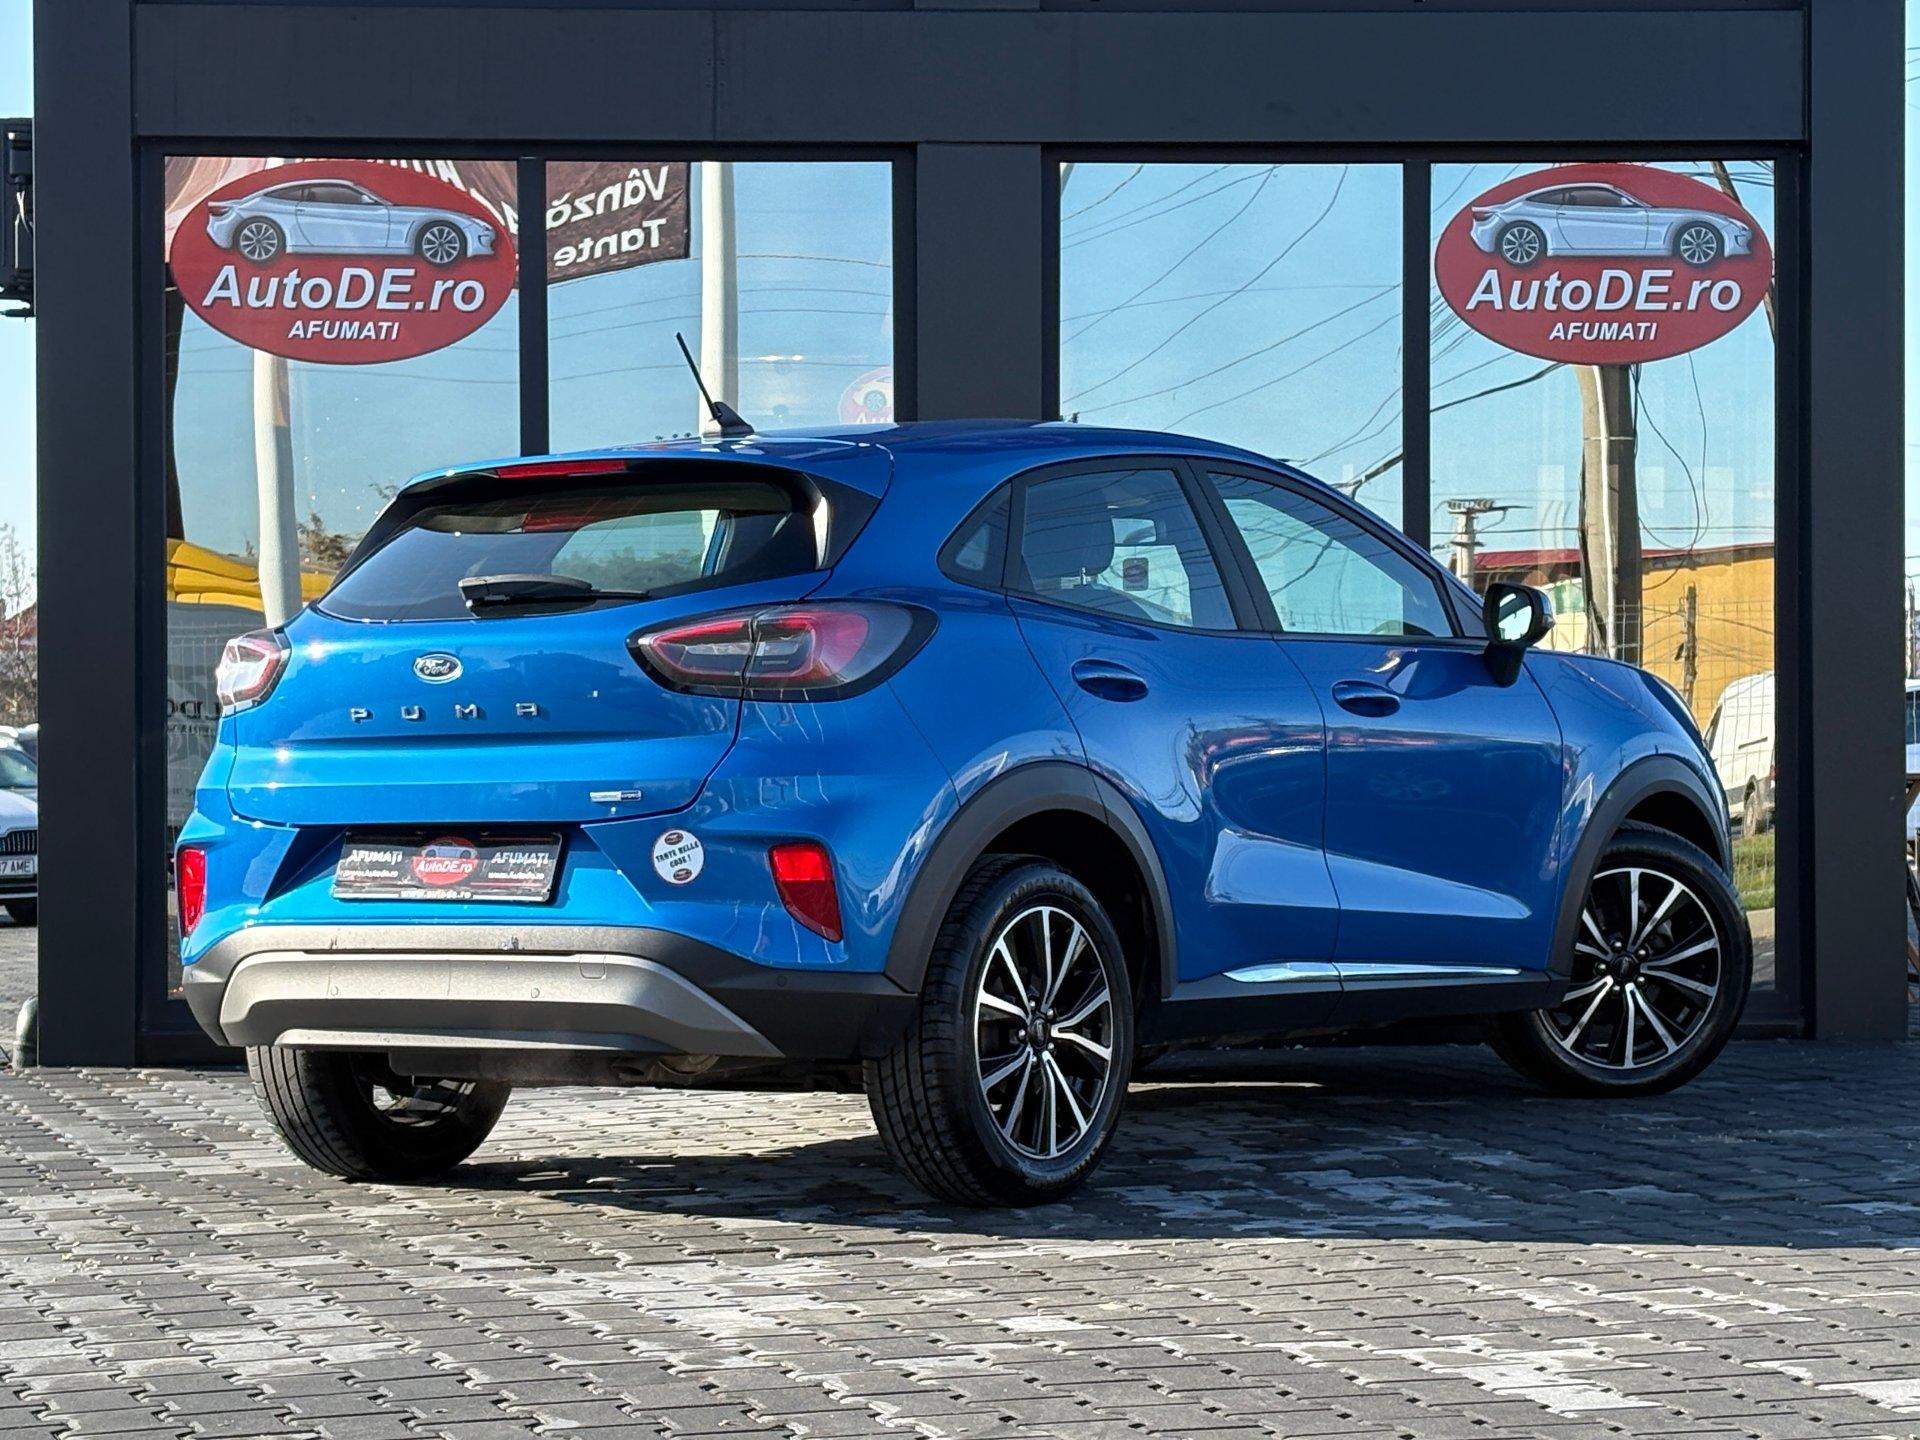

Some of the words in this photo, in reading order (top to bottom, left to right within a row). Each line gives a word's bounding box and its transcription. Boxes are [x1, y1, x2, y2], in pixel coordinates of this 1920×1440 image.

[202, 265, 486, 312] AutoDE.ro
[1466, 269, 1742, 312] AutoDE.ro
[288, 320, 400, 341] AFUMATI
[1549, 323, 1658, 342] AFUMATI
[420, 658, 450, 674] Ford
[350, 703, 538, 722] PUMA
[415, 860, 473, 873] AutoDE.ro
